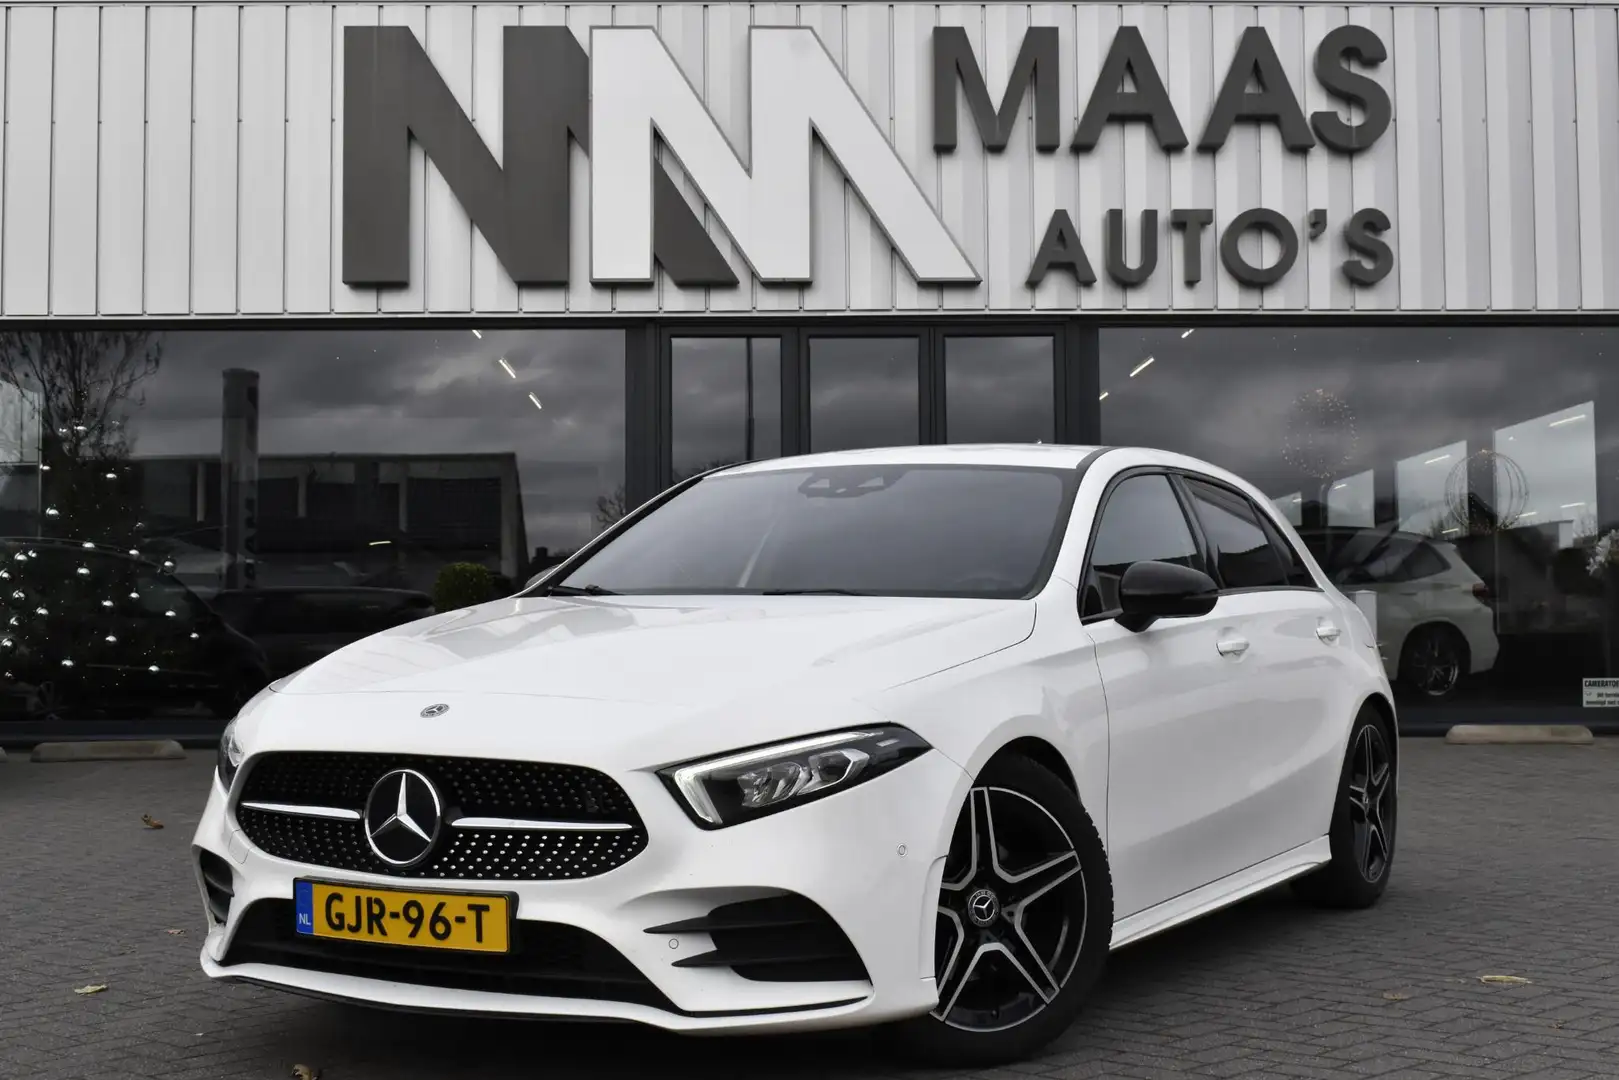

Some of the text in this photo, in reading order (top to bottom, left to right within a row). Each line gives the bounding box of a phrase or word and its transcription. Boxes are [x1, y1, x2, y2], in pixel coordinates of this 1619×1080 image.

[932, 24, 1392, 154] MAAS
[1025, 207, 1394, 287] AUTO'S
[298, 912, 311, 926] NL
[325, 892, 490, 944] GJR-96-T
